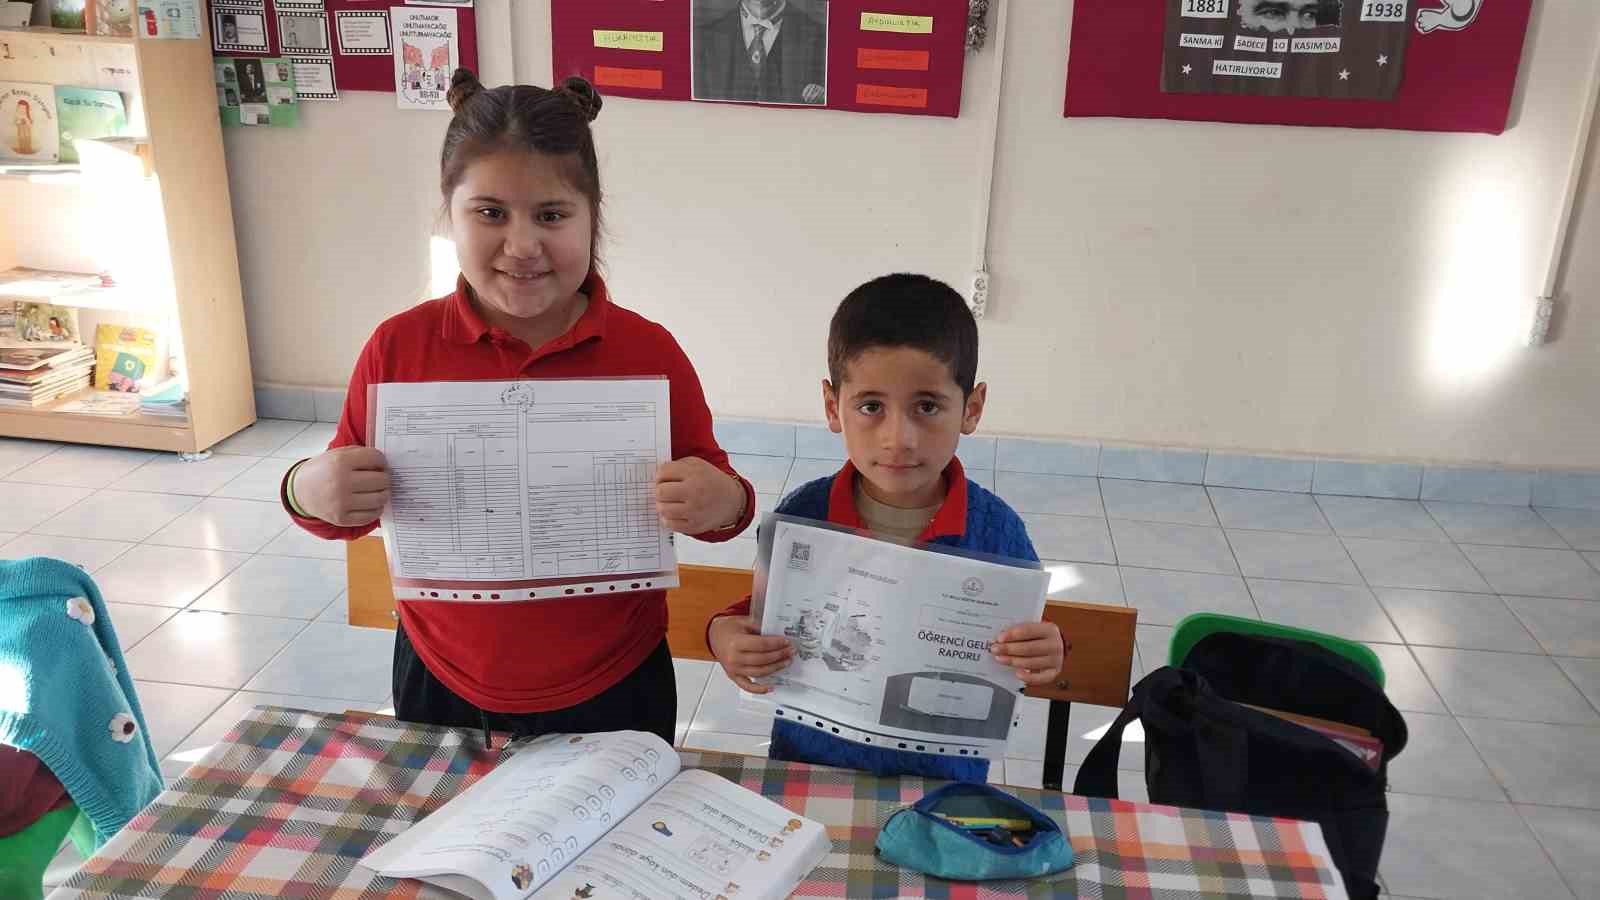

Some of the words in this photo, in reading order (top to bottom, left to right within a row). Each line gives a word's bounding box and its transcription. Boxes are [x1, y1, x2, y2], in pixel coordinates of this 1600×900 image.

[1187, 0, 1224, 13] 1881
[1366, 3, 1403, 17] 1938
[1183, 36, 1212, 46] SANMA
[1236, 39, 1266, 50] SADECE
[1215, 63, 1280, 76] HATIRLIYORUZ
[918, 629, 966, 648] ÖĞRENCİ
[938, 647, 981, 662] RAPORU
